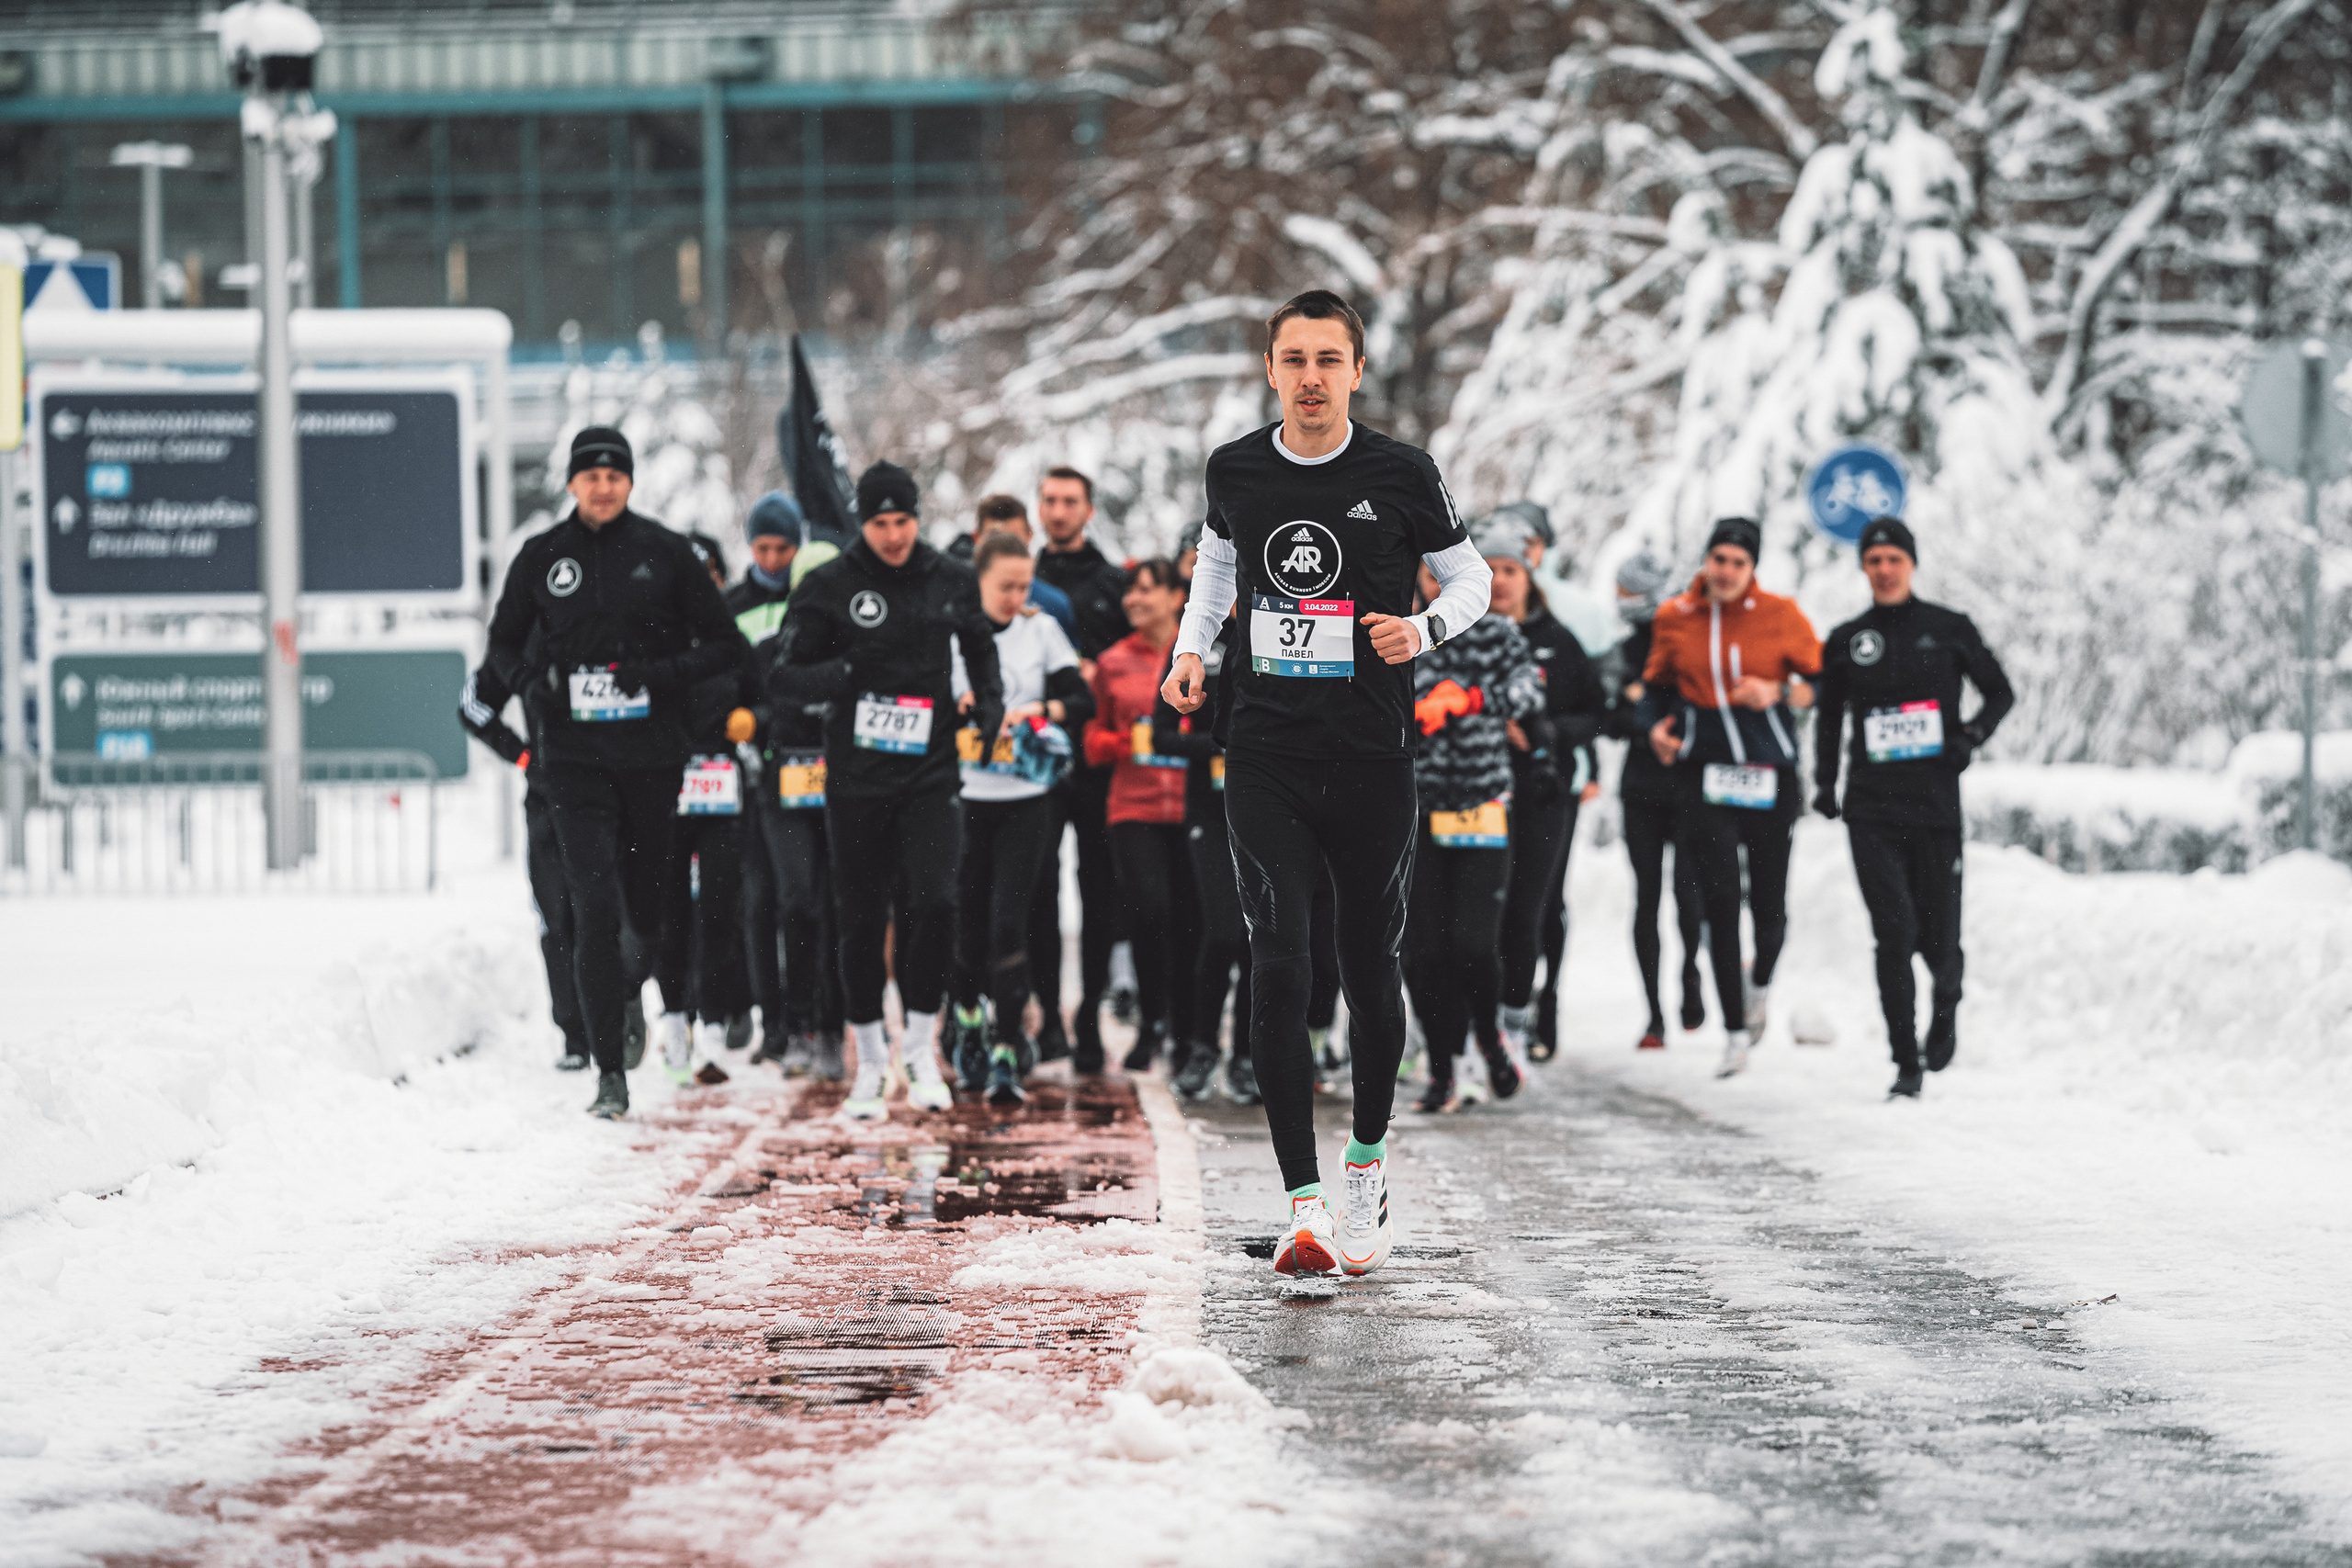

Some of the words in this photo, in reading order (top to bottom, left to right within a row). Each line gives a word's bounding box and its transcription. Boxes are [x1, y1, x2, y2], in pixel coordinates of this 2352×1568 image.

[1347, 511, 1377, 521] adidas
[1279, 617, 1316, 648] 37
[1281, 649, 1314, 659] ПАВЕЛ
[866, 706, 920, 731] 2787
